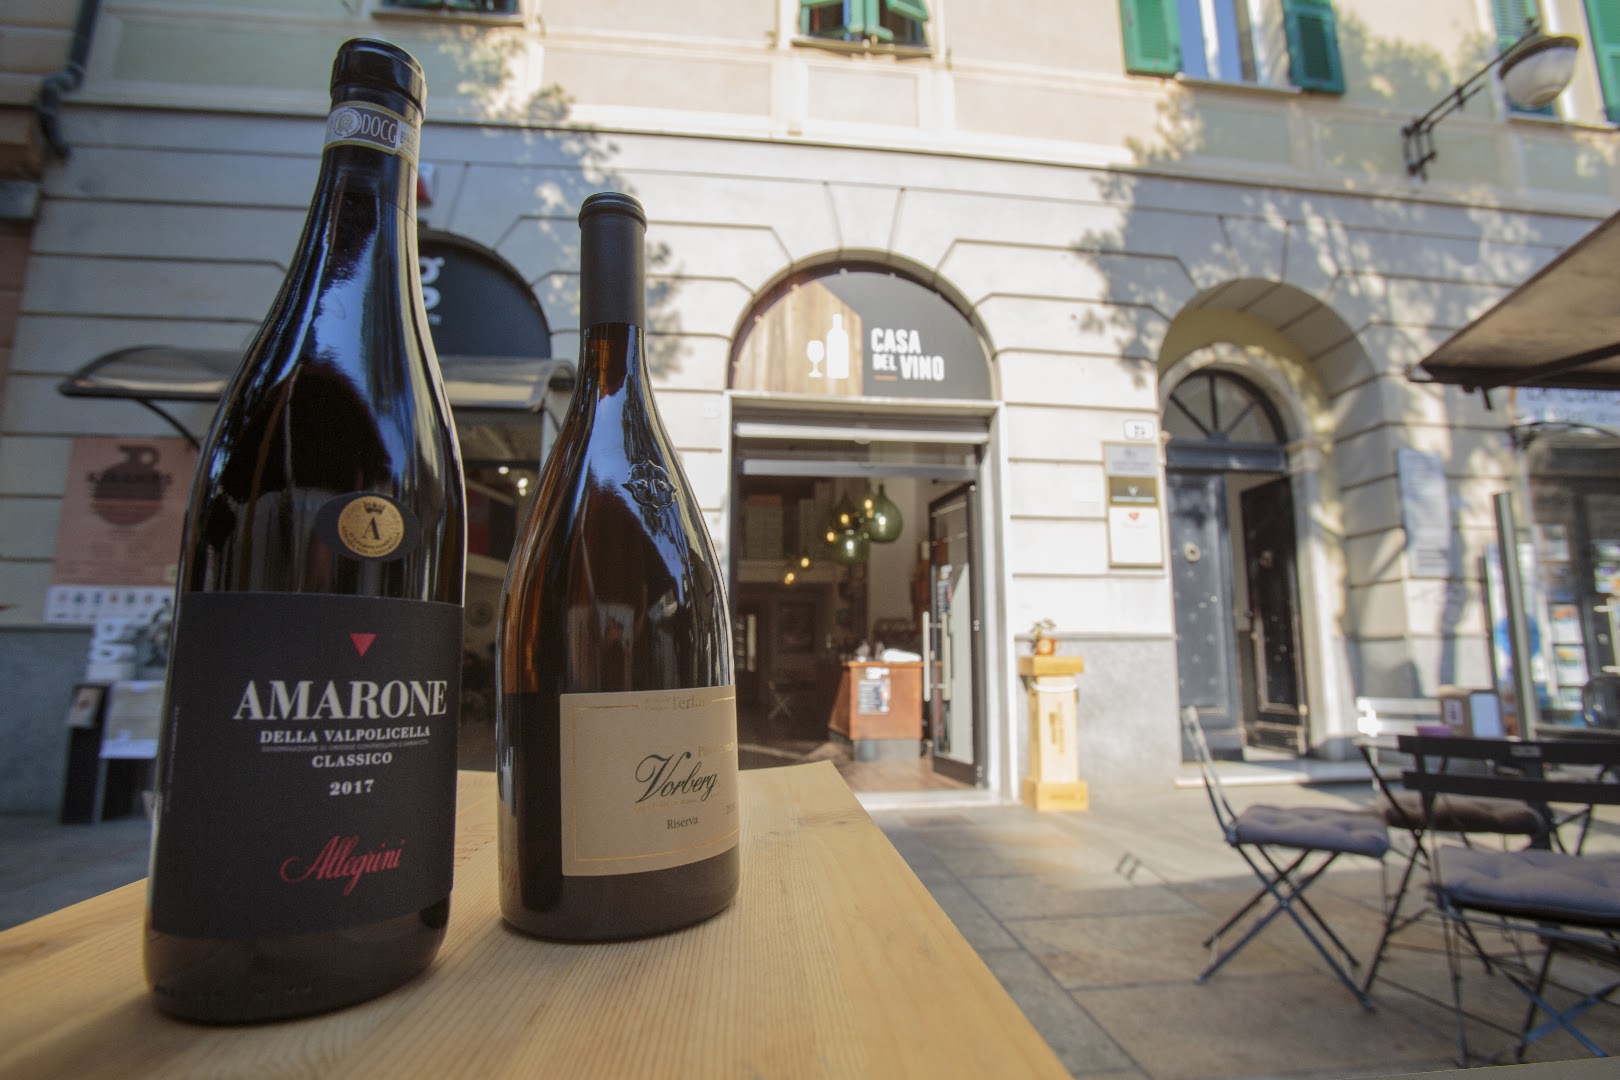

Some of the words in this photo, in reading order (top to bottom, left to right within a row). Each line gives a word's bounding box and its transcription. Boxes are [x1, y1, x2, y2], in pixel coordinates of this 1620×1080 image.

[361, 113, 397, 144] DOCG
[871, 327, 922, 354] CASA
[872, 353, 898, 371] DEL
[899, 354, 944, 381] VINO
[232, 679, 448, 720] AMARONE
[259, 730, 318, 744] DELLA
[323, 726, 430, 743] VALPOLICELLA
[311, 752, 392, 768] CLASSICO
[329, 779, 375, 796] 2017
[635, 751, 718, 803] Vorberg
[667, 816, 699, 830] Riserva
[279, 834, 407, 897] Allegrini
